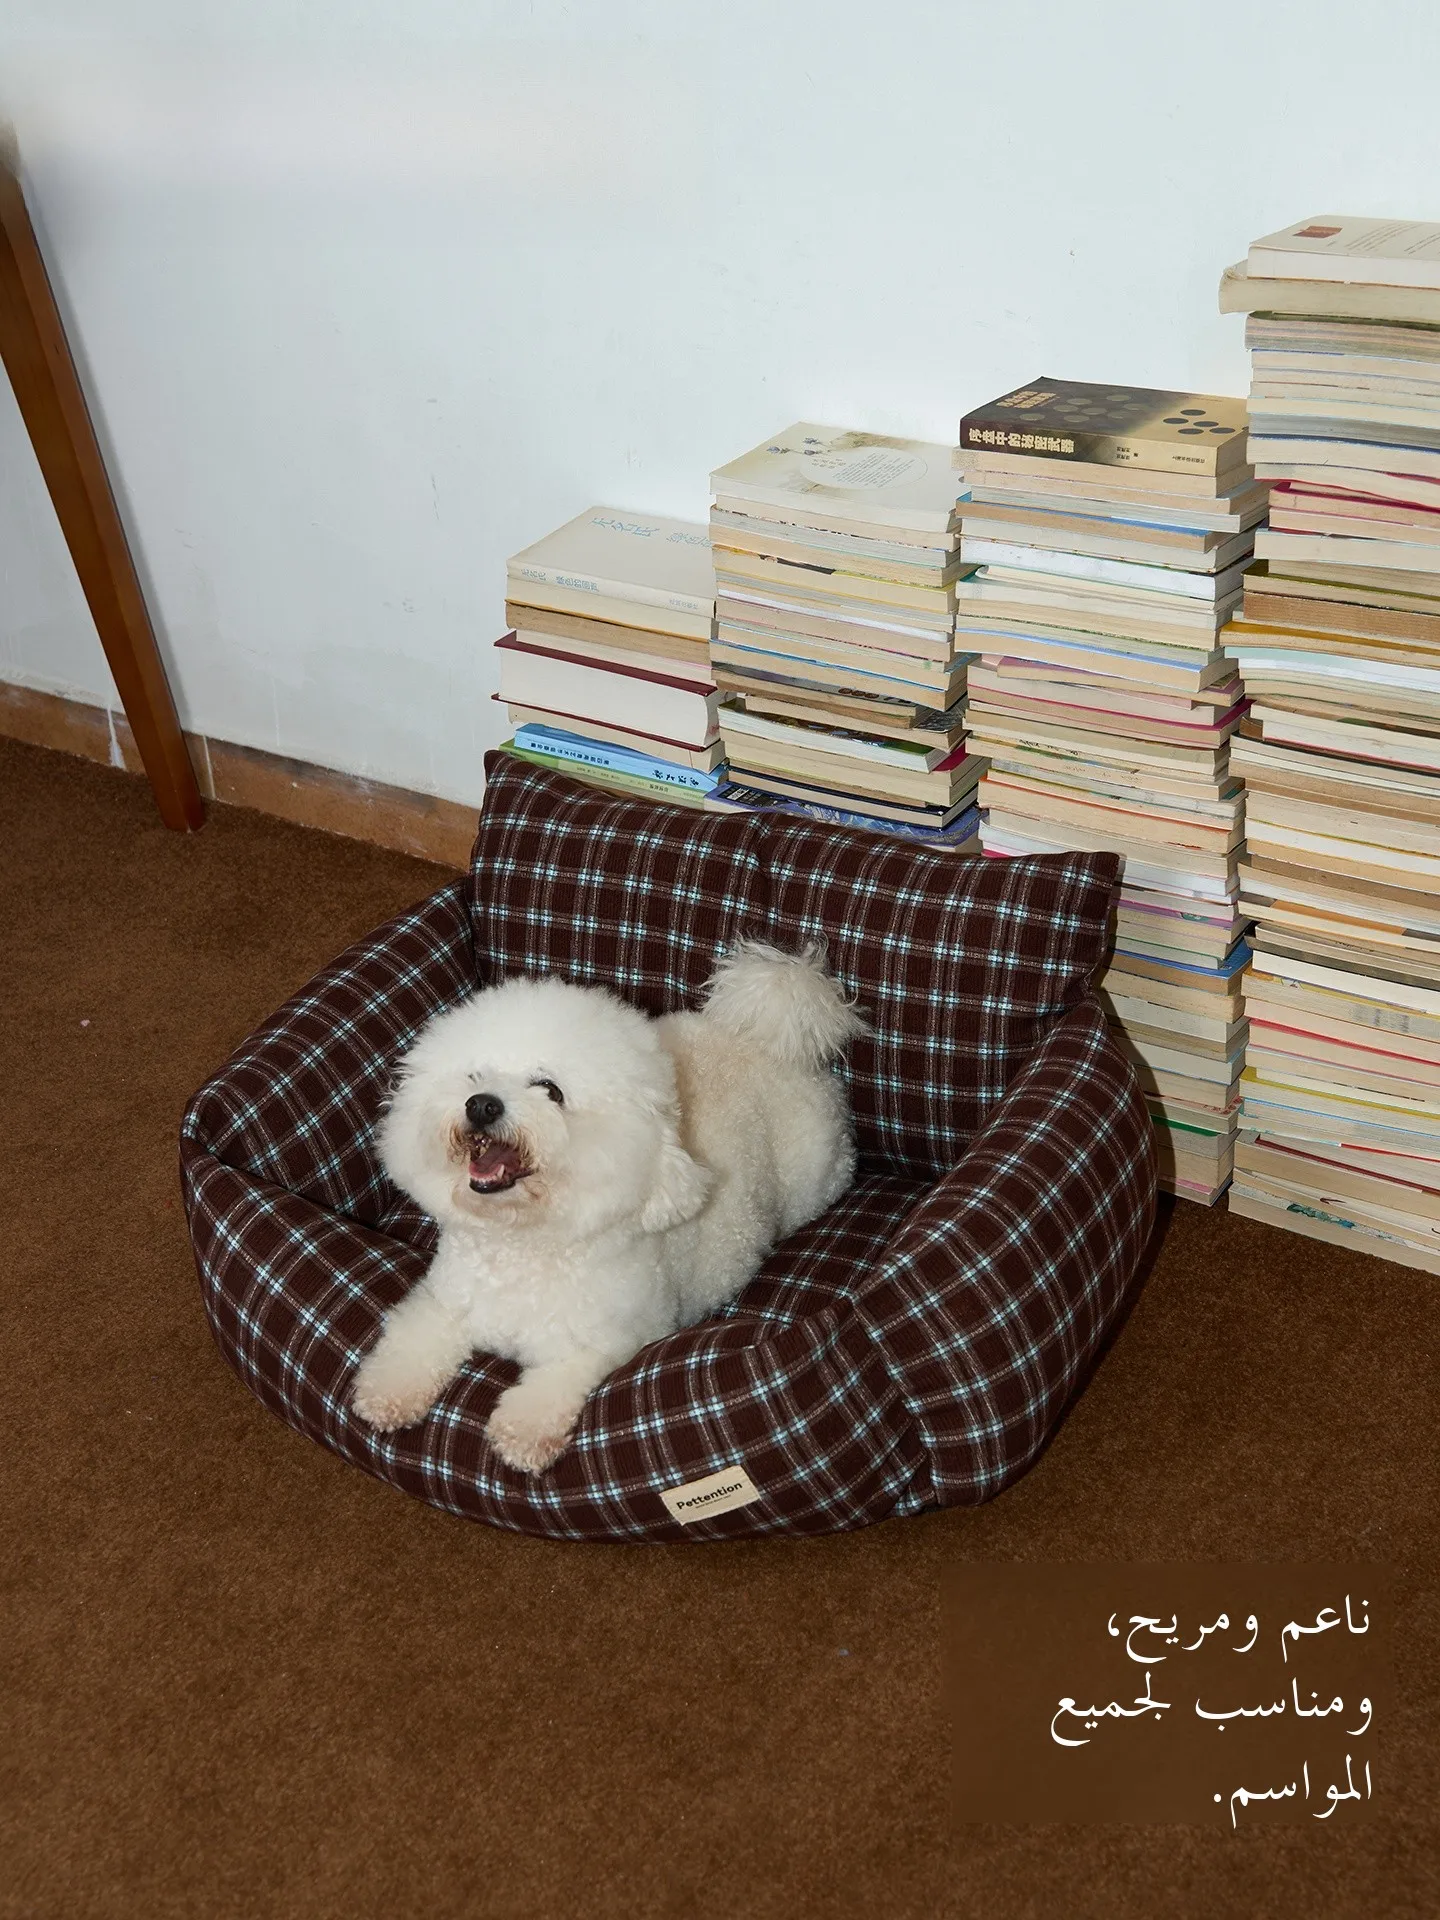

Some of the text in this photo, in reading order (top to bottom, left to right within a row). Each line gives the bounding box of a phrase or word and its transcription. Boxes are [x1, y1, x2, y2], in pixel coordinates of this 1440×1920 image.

[968, 427, 1075, 453] 序盘中的秘密武器
[676, 1482, 743, 1509] Pettention
